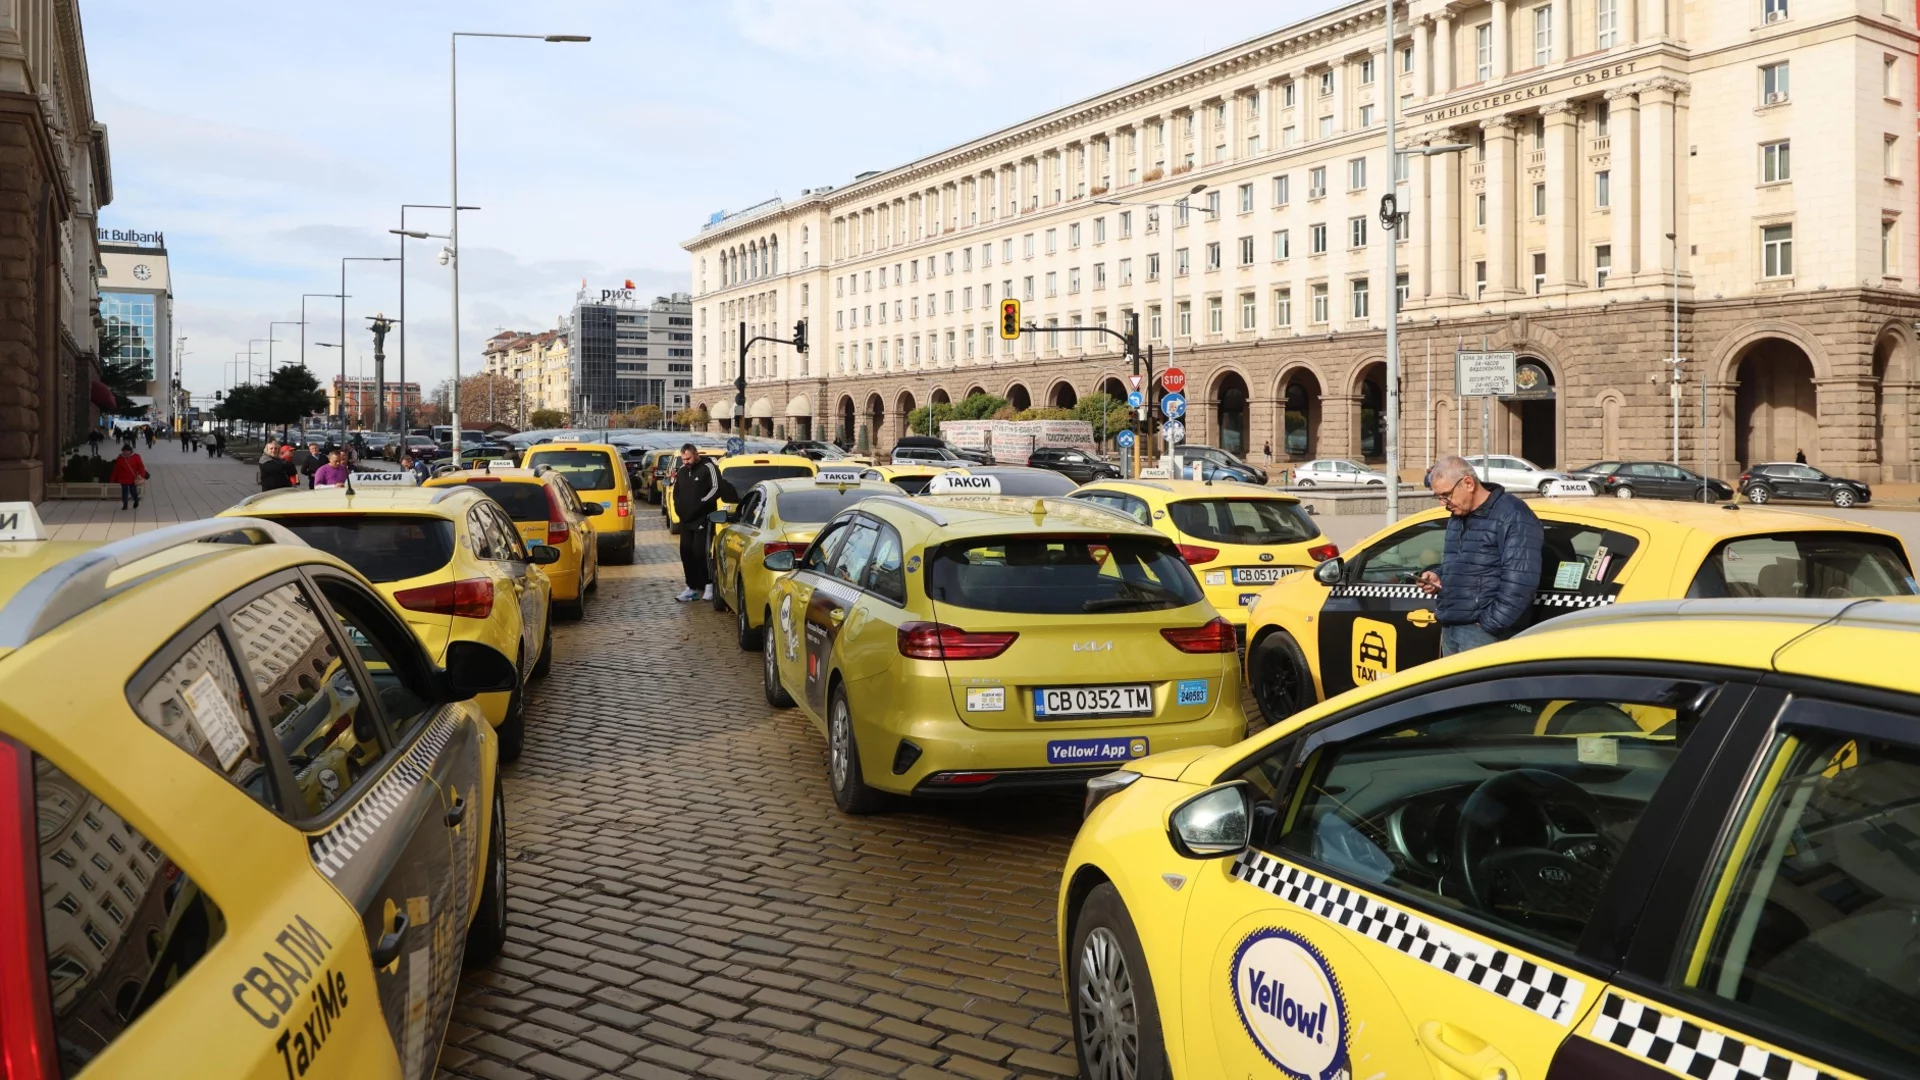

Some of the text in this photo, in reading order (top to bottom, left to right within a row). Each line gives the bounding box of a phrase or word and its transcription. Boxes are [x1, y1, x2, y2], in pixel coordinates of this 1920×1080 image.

[1423, 62, 1637, 123] МИНИСТЕРСКИ СЪВЕТ
[112, 229, 163, 243] Bulbank
[601, 288, 632, 301] pwc
[1164, 375, 1183, 384] STOP
[355, 473, 403, 481] ТАКСИ
[1146, 468, 1165, 476] ТАКСИ
[946, 476, 991, 488] ТАКСИ
[1239, 569, 1251, 581] CB
[1253, 569, 1279, 581] 0512
[1047, 691, 1072, 711] CB
[1077, 690, 1121, 710] 0352
[1123, 688, 1148, 708] TM
[1181, 690, 1204, 702] 240583
[1052, 743, 1126, 759] Yellow! App
[232, 914, 333, 1029] СВАЛИ
[1248, 967, 1328, 1044] Yellow!
[276, 968, 348, 1080] TaxiMe
